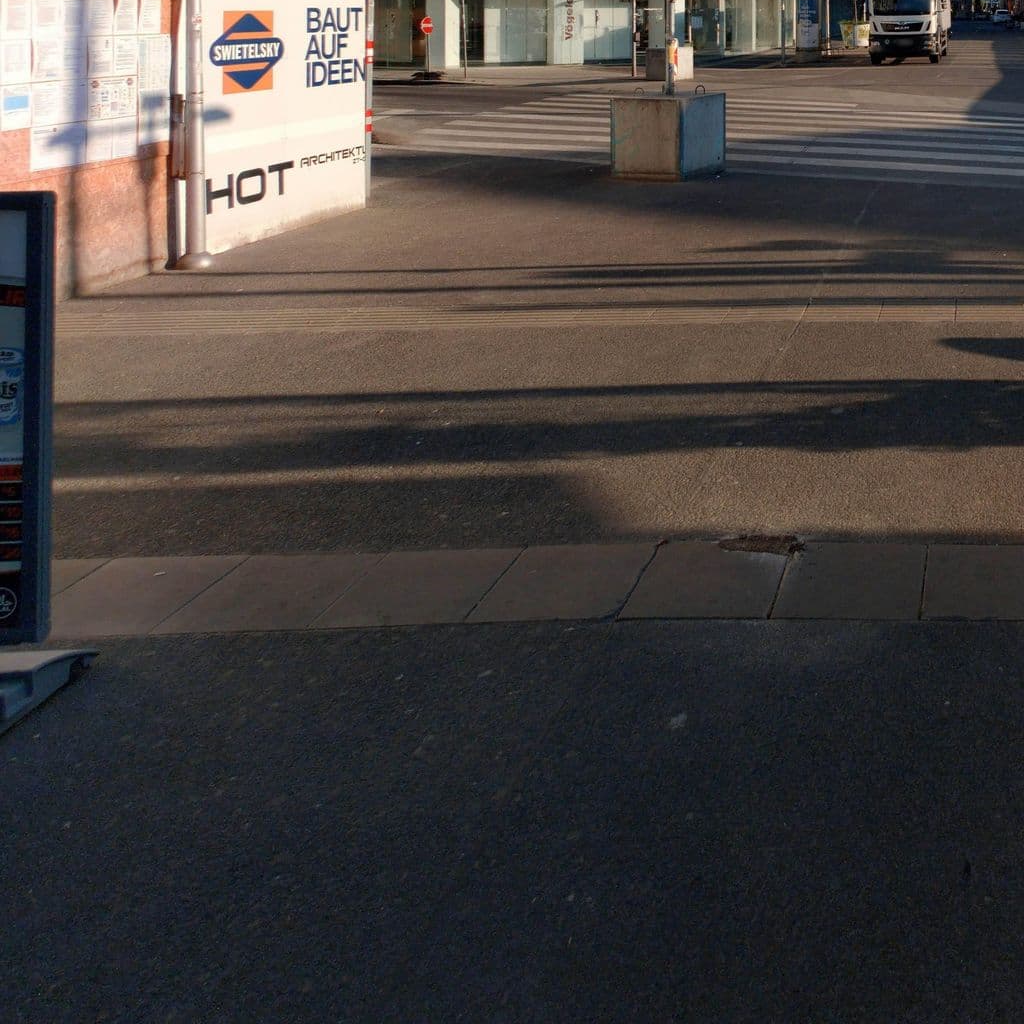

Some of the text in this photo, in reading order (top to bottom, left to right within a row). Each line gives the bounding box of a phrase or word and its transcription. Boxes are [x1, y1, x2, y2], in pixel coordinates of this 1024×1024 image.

[306, 7, 363, 33] BAUT
[214, 42, 281, 61] SWIETELSKY
[305, 34, 349, 60] AUF
[306, 59, 366, 88] IDEEN
[206, 160, 294, 215] HOT
